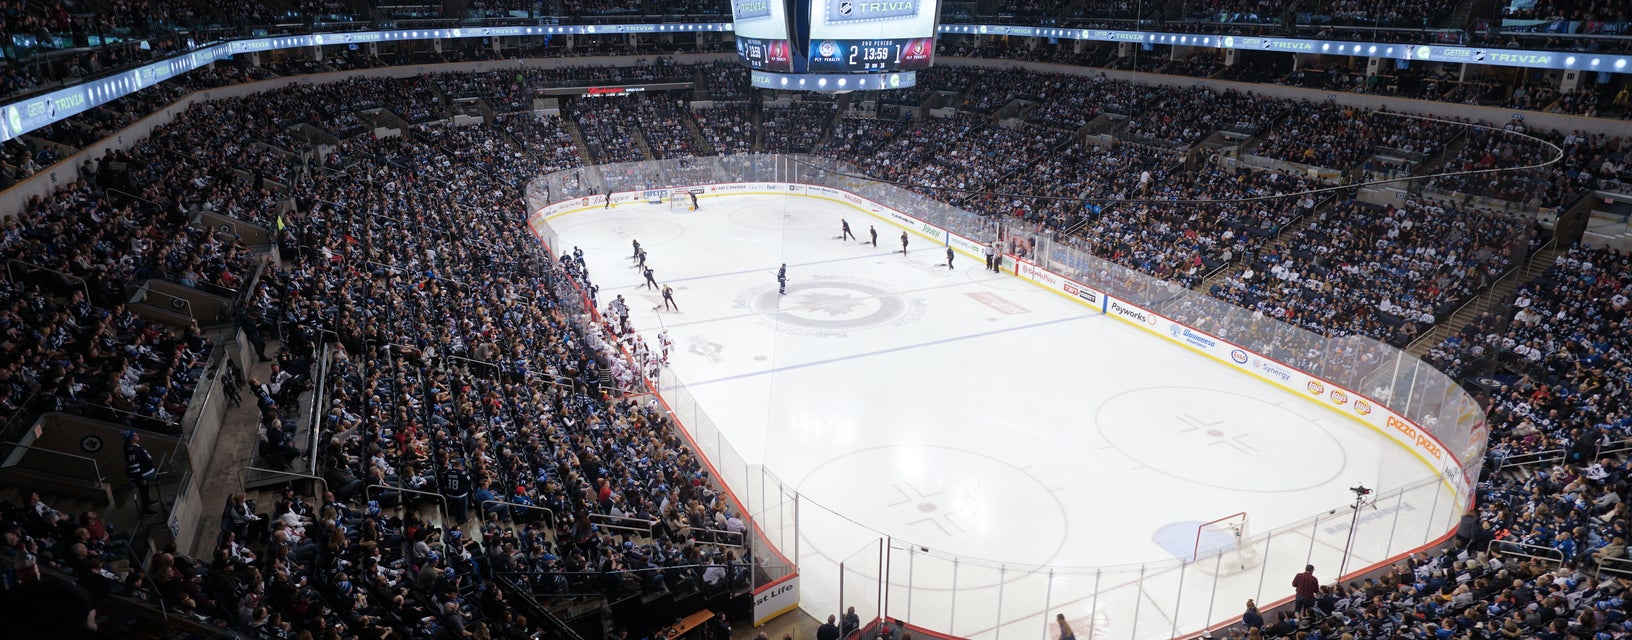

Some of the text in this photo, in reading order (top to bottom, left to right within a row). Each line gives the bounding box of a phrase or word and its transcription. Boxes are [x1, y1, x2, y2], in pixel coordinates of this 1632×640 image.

[859, 2, 912, 13] TRIVIA
[863, 47, 888, 60] 13:59
[894, 44, 900, 64] 1
[1273, 41, 1311, 49] TRIVIA
[849, 45, 858, 65] 2
[1490, 53, 1549, 64] TRIVIA
[752, 75, 770, 84] RIVIA
[54, 92, 85, 111] TRIVIA
[643, 190, 668, 199] POPEYES
[1111, 302, 1146, 323] Payworks
[1183, 328, 1215, 347] Wawanesa
[1262, 363, 1291, 381] Synergy
[1386, 415, 1442, 460] pizza pizza
[448, 479, 459, 490] 18
[753, 584, 793, 606] st Life
